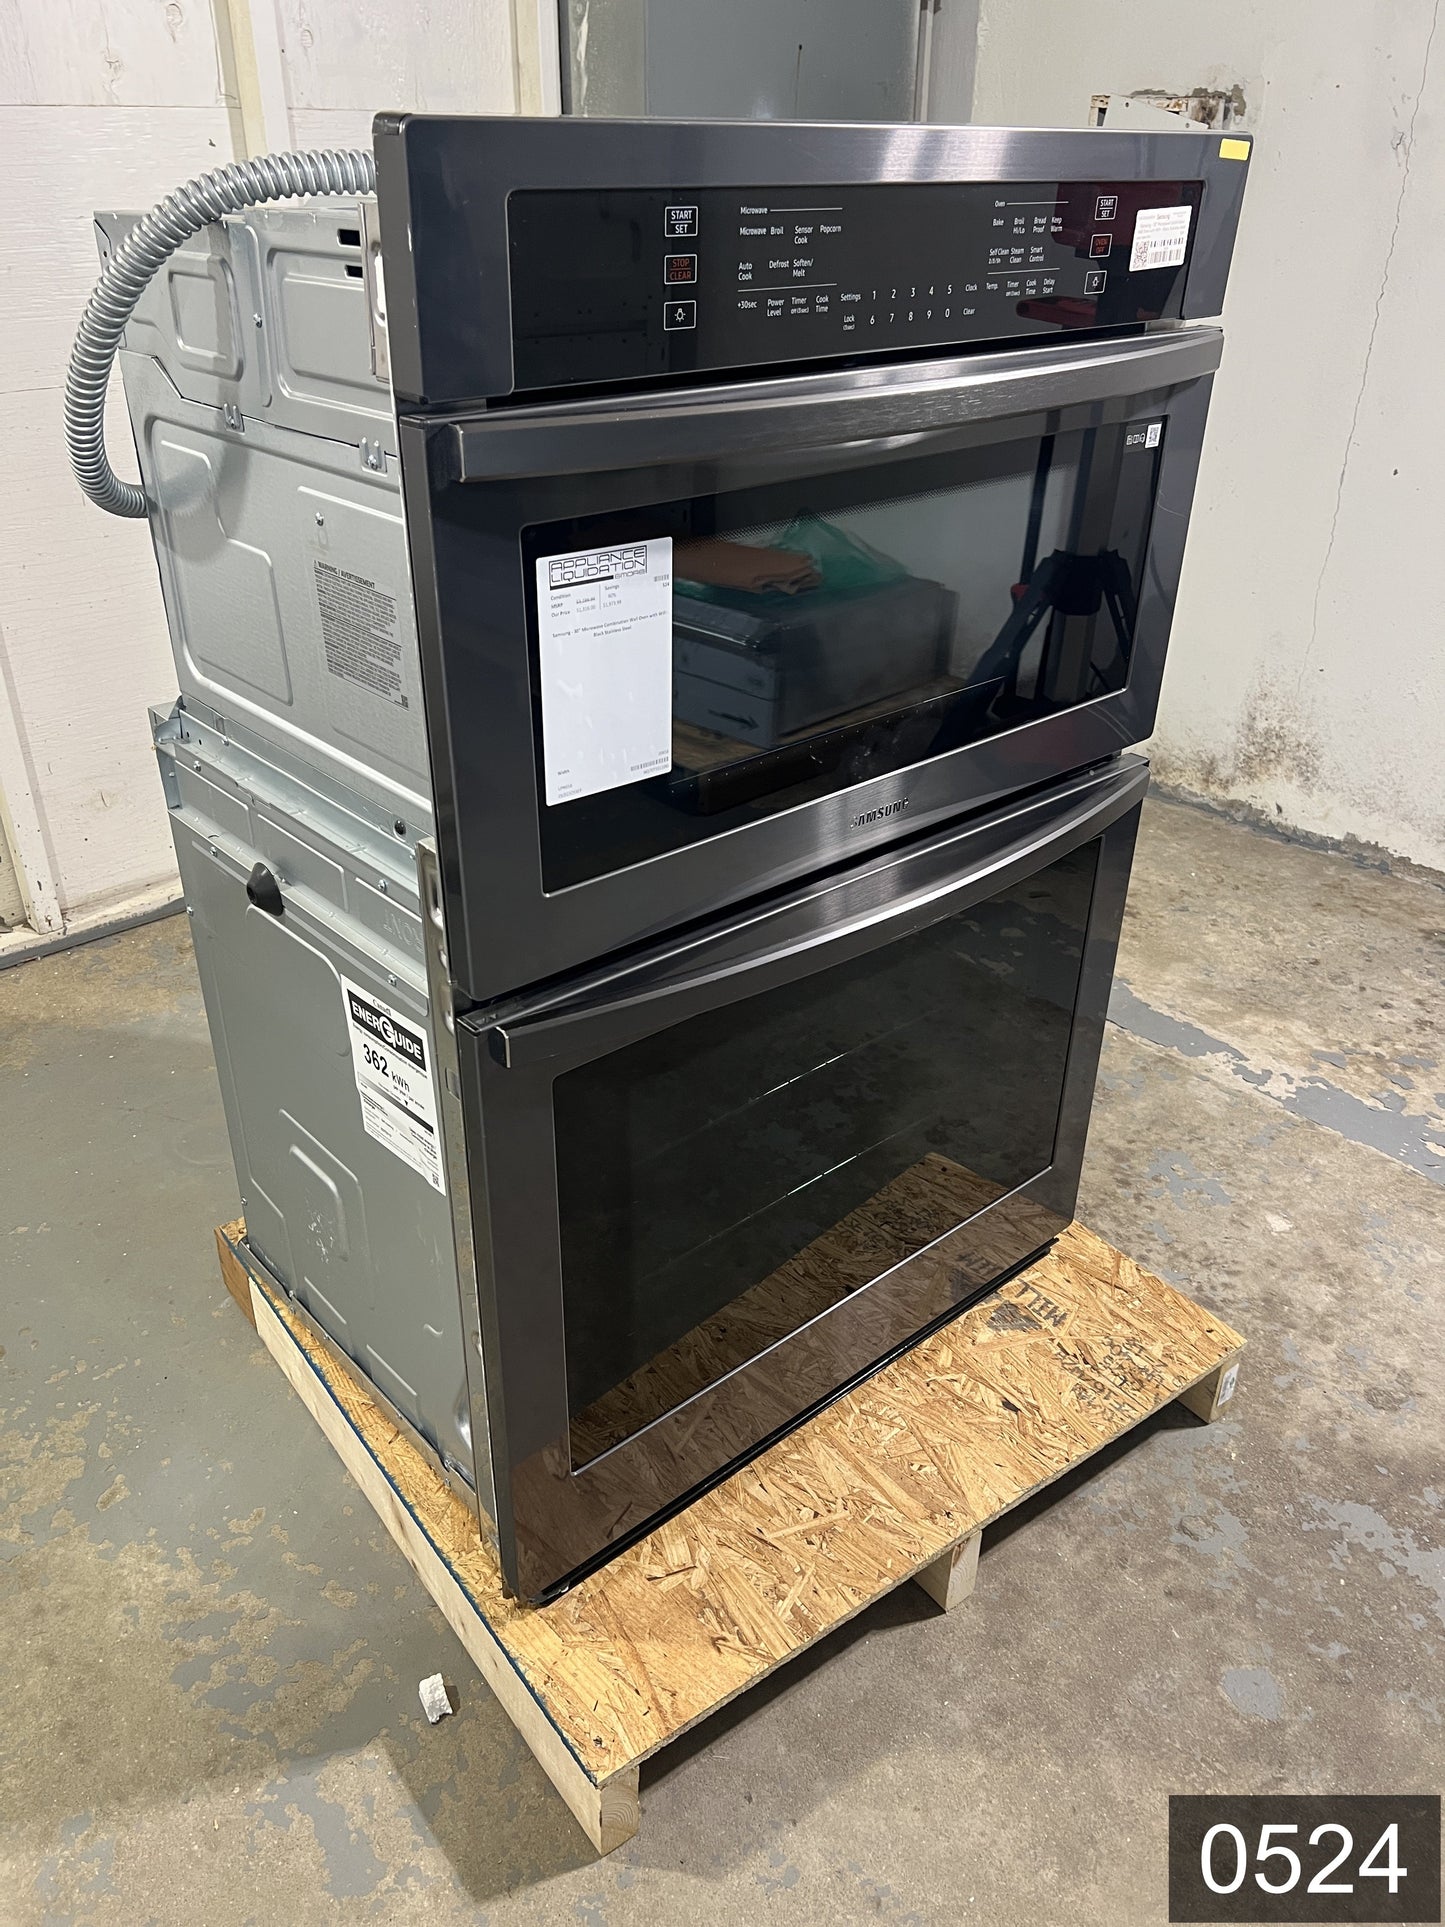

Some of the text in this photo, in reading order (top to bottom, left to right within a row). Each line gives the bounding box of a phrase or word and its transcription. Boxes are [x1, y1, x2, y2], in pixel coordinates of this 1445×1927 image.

[671, 210, 692, 219] START
[1014, 217, 1024, 225] Broil
[675, 224, 688, 233] SET
[740, 227, 766, 235] Microwave
[771, 227, 783, 235] Broil
[795, 226, 813, 234] Sensor
[820, 225, 841, 234] Popcorn
[1033, 225, 1045, 233] Proof
[795, 236, 807, 244] Cook
[672, 258, 689, 267] STOP
[739, 262, 752, 270] Auto
[769, 260, 789, 268] Defrost
[794, 259, 813, 267] Soften/
[670, 271, 691, 280] CLEAR
[738, 272, 752, 280] Cook
[793, 269, 805, 277] Melt
[1044, 278, 1055, 286] Delay
[872, 284, 952, 300] 1 2 3 4 5
[816, 295, 828, 303] Cook
[841, 294, 861, 302] Settings
[768, 299, 784, 307] Power
[767, 308, 781, 316] Level
[869, 308, 951, 325] 6 7 8 9 0
[551, 547, 645, 572] APPLIANCE
[551, 558, 645, 582] LIQUIDATION
[341, 570, 375, 590] AVERTISSEMENT
[850, 798, 909, 829] SAMSUNG
[351, 1000, 422, 1060] ENERGUIDE
[363, 1043, 389, 1077] 362
[391, 1071, 410, 1092] kWh
[1015, 1279, 1068, 1327] MILL
